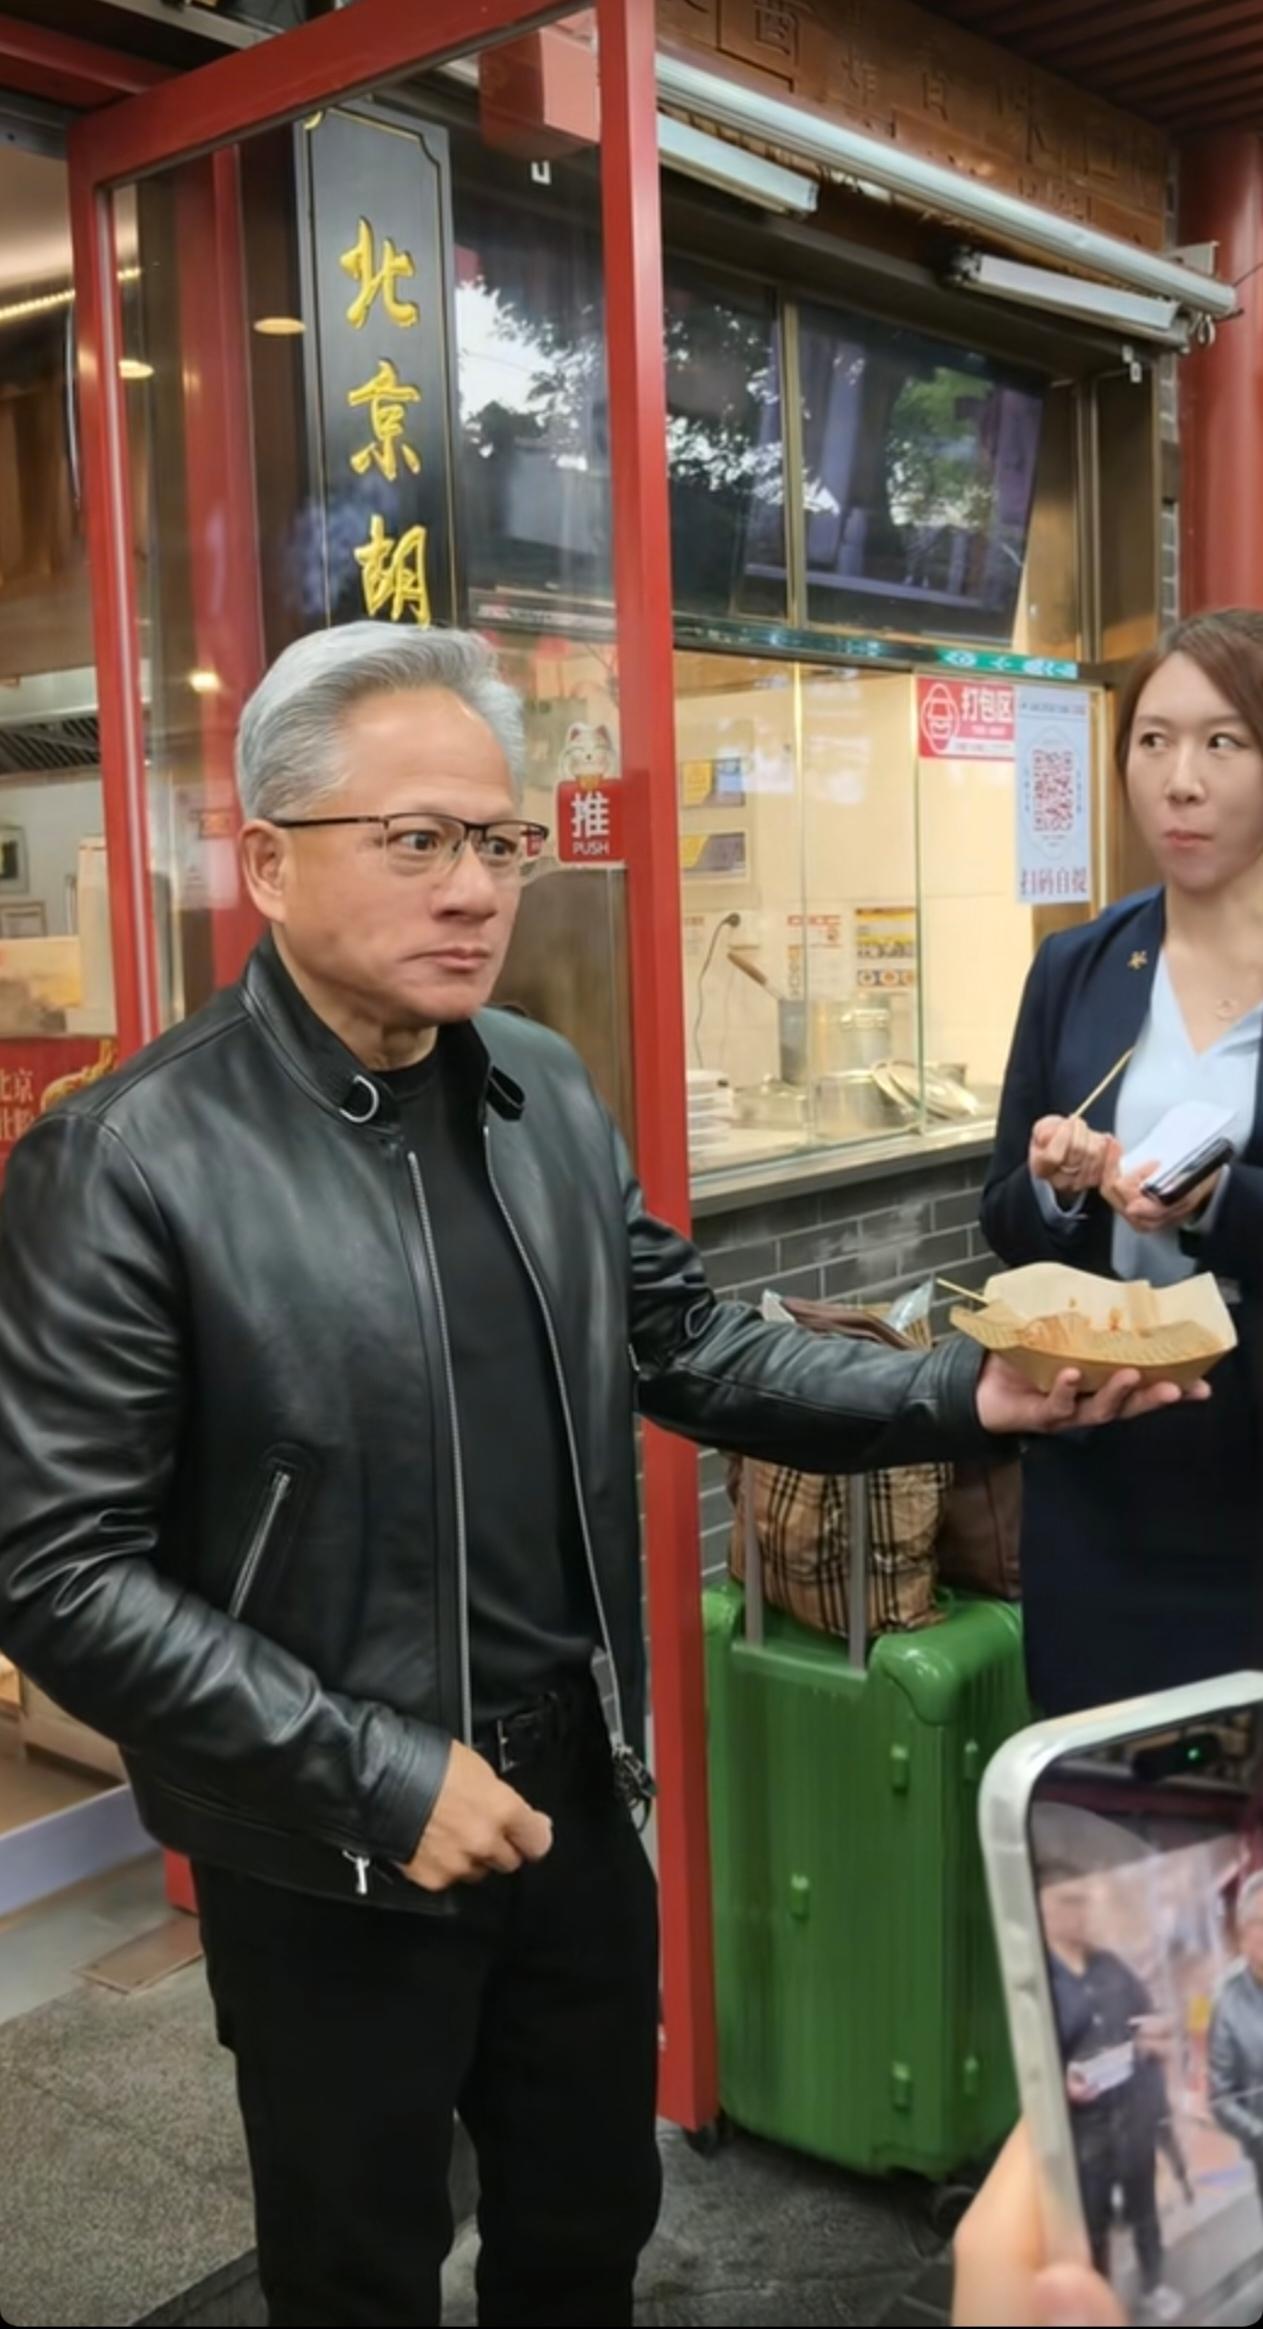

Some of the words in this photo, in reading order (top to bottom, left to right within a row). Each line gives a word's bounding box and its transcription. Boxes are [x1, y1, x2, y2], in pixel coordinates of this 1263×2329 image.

[340, 215, 431, 629] 北京胡
[961, 686, 1013, 723] 打包区
[570, 791, 610, 838] 推
[572, 841, 610, 856] PUSH
[1020, 866, 1087, 896] 扫码自提
